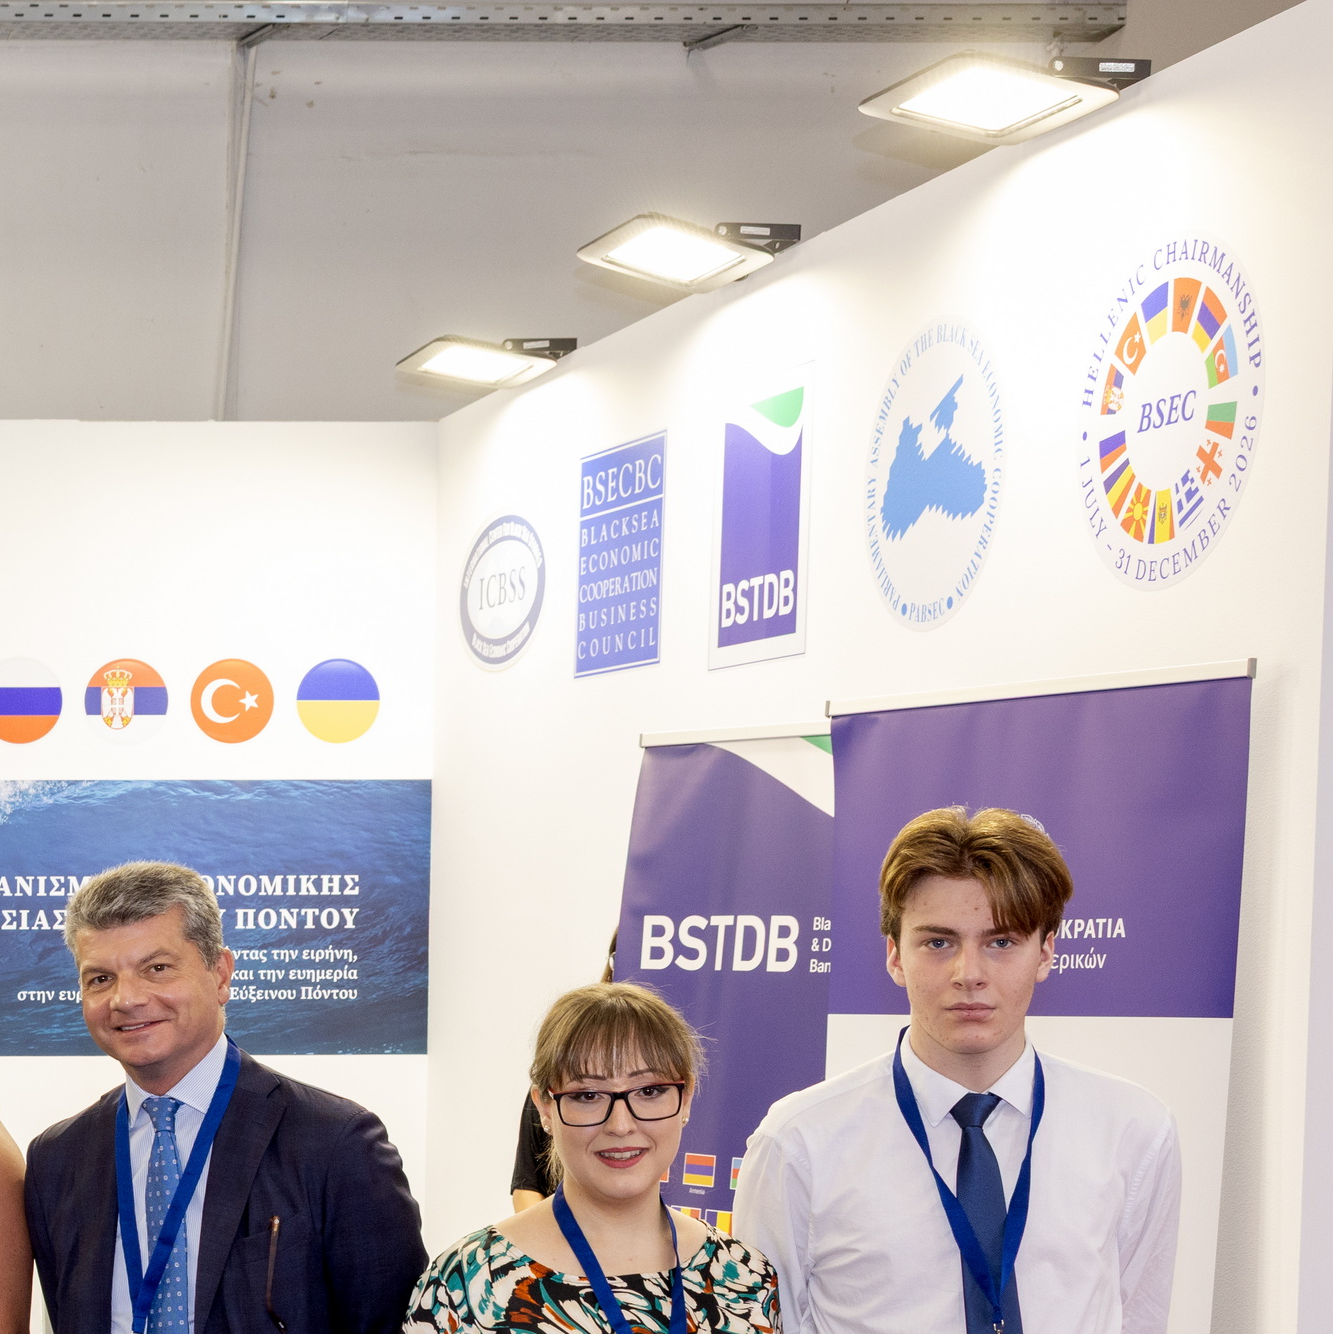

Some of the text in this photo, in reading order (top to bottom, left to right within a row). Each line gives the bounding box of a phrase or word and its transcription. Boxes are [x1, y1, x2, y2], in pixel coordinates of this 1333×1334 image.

[936, 323, 969, 348] BLACK
[1082, 239, 1262, 408] HELLENIC CHAIRMANSHIP
[913, 328, 933, 358] THE
[968, 336, 985, 366] SEA
[900, 350, 912, 376] OF
[870, 373, 900, 469] ASSEMBLY
[982, 360, 1004, 461] ECONOMIC
[1137, 390, 1197, 433] BSEC
[582, 454, 662, 510] BSECBC
[1081, 478, 1107, 540] JULY
[1115, 548, 1132, 575] 31
[1135, 497, 1232, 582] DECEMBER
[1228, 415, 1258, 492] 2026
[581, 508, 659, 548] BLACKSEA
[955, 468, 1002, 601] COOPERATION
[580, 538, 659, 575] ECONOMIC
[479, 566, 526, 611] ICBSS
[579, 567, 658, 603] COOPERATION
[721, 569, 795, 628] BSTDB
[578, 596, 657, 632] BUSINESS
[908, 597, 945, 623] PABSEC
[577, 627, 656, 660] COUNCIL
[235, 908, 360, 930] ΠΟΝΤΟΥ
[272, 948, 298, 963] την
[302, 945, 358, 963] ειρήνη,
[640, 914, 800, 973] BSTDB
[811, 938, 820, 952] &
[258, 967, 284, 983] την
[288, 966, 358, 983] ευημερία
[17, 989, 54, 1003] στην
[229, 986, 296, 1004] Εύξεινου
[301, 985, 358, 1001] Πόντου
